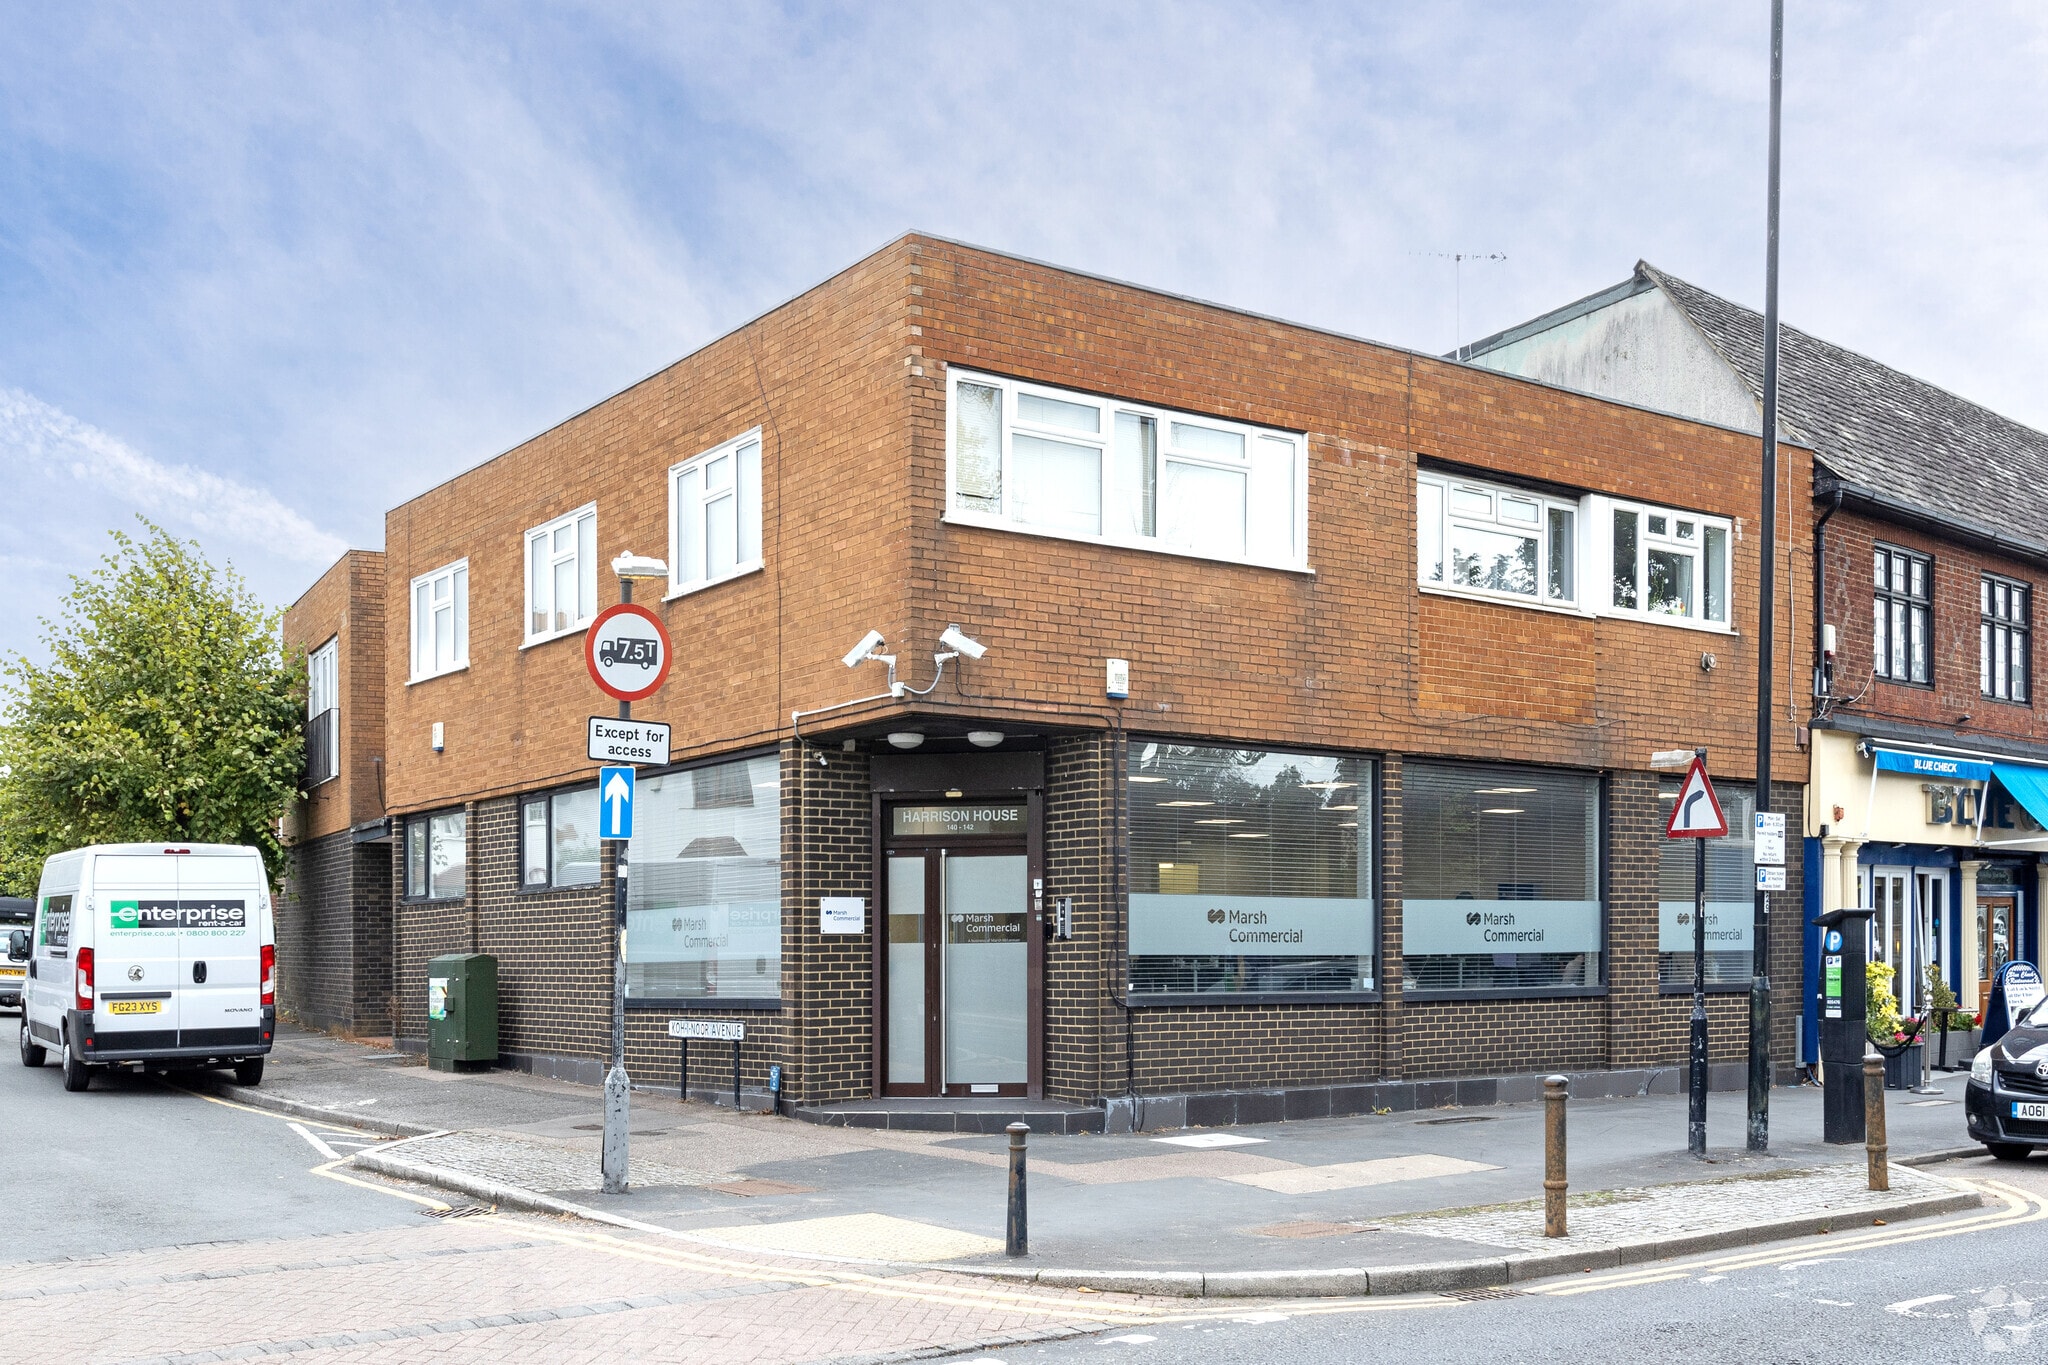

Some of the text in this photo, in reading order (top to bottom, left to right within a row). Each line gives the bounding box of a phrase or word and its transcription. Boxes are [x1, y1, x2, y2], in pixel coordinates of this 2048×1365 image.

[619, 640, 656, 660] 7.5T
[595, 724, 664, 743] Except for
[608, 744, 652, 758] access
[1914, 759, 1957, 773] BLUE CHECK
[903, 809, 1018, 822] HARRISON HOUSE
[118, 904, 244, 924] enterprise
[966, 914, 994, 923] Marsh
[1229, 909, 1267, 924] Marsh
[1484, 912, 1515, 926] Marsh
[1692, 913, 1718, 925] rsh
[684, 917, 707, 931] Marsh
[966, 923, 1020, 932] Commercial
[110, 930, 176, 938] enterprise.co.uk
[684, 933, 729, 948] Commercial
[1229, 928, 1303, 943] Commercial
[1484, 929, 1544, 942] Commercial
[1830, 931, 1840, 951] P
[112, 1002, 158, 1012] FG23 XYS
[671, 1022, 741, 1038] KOH-I-NOOR AVENUE
